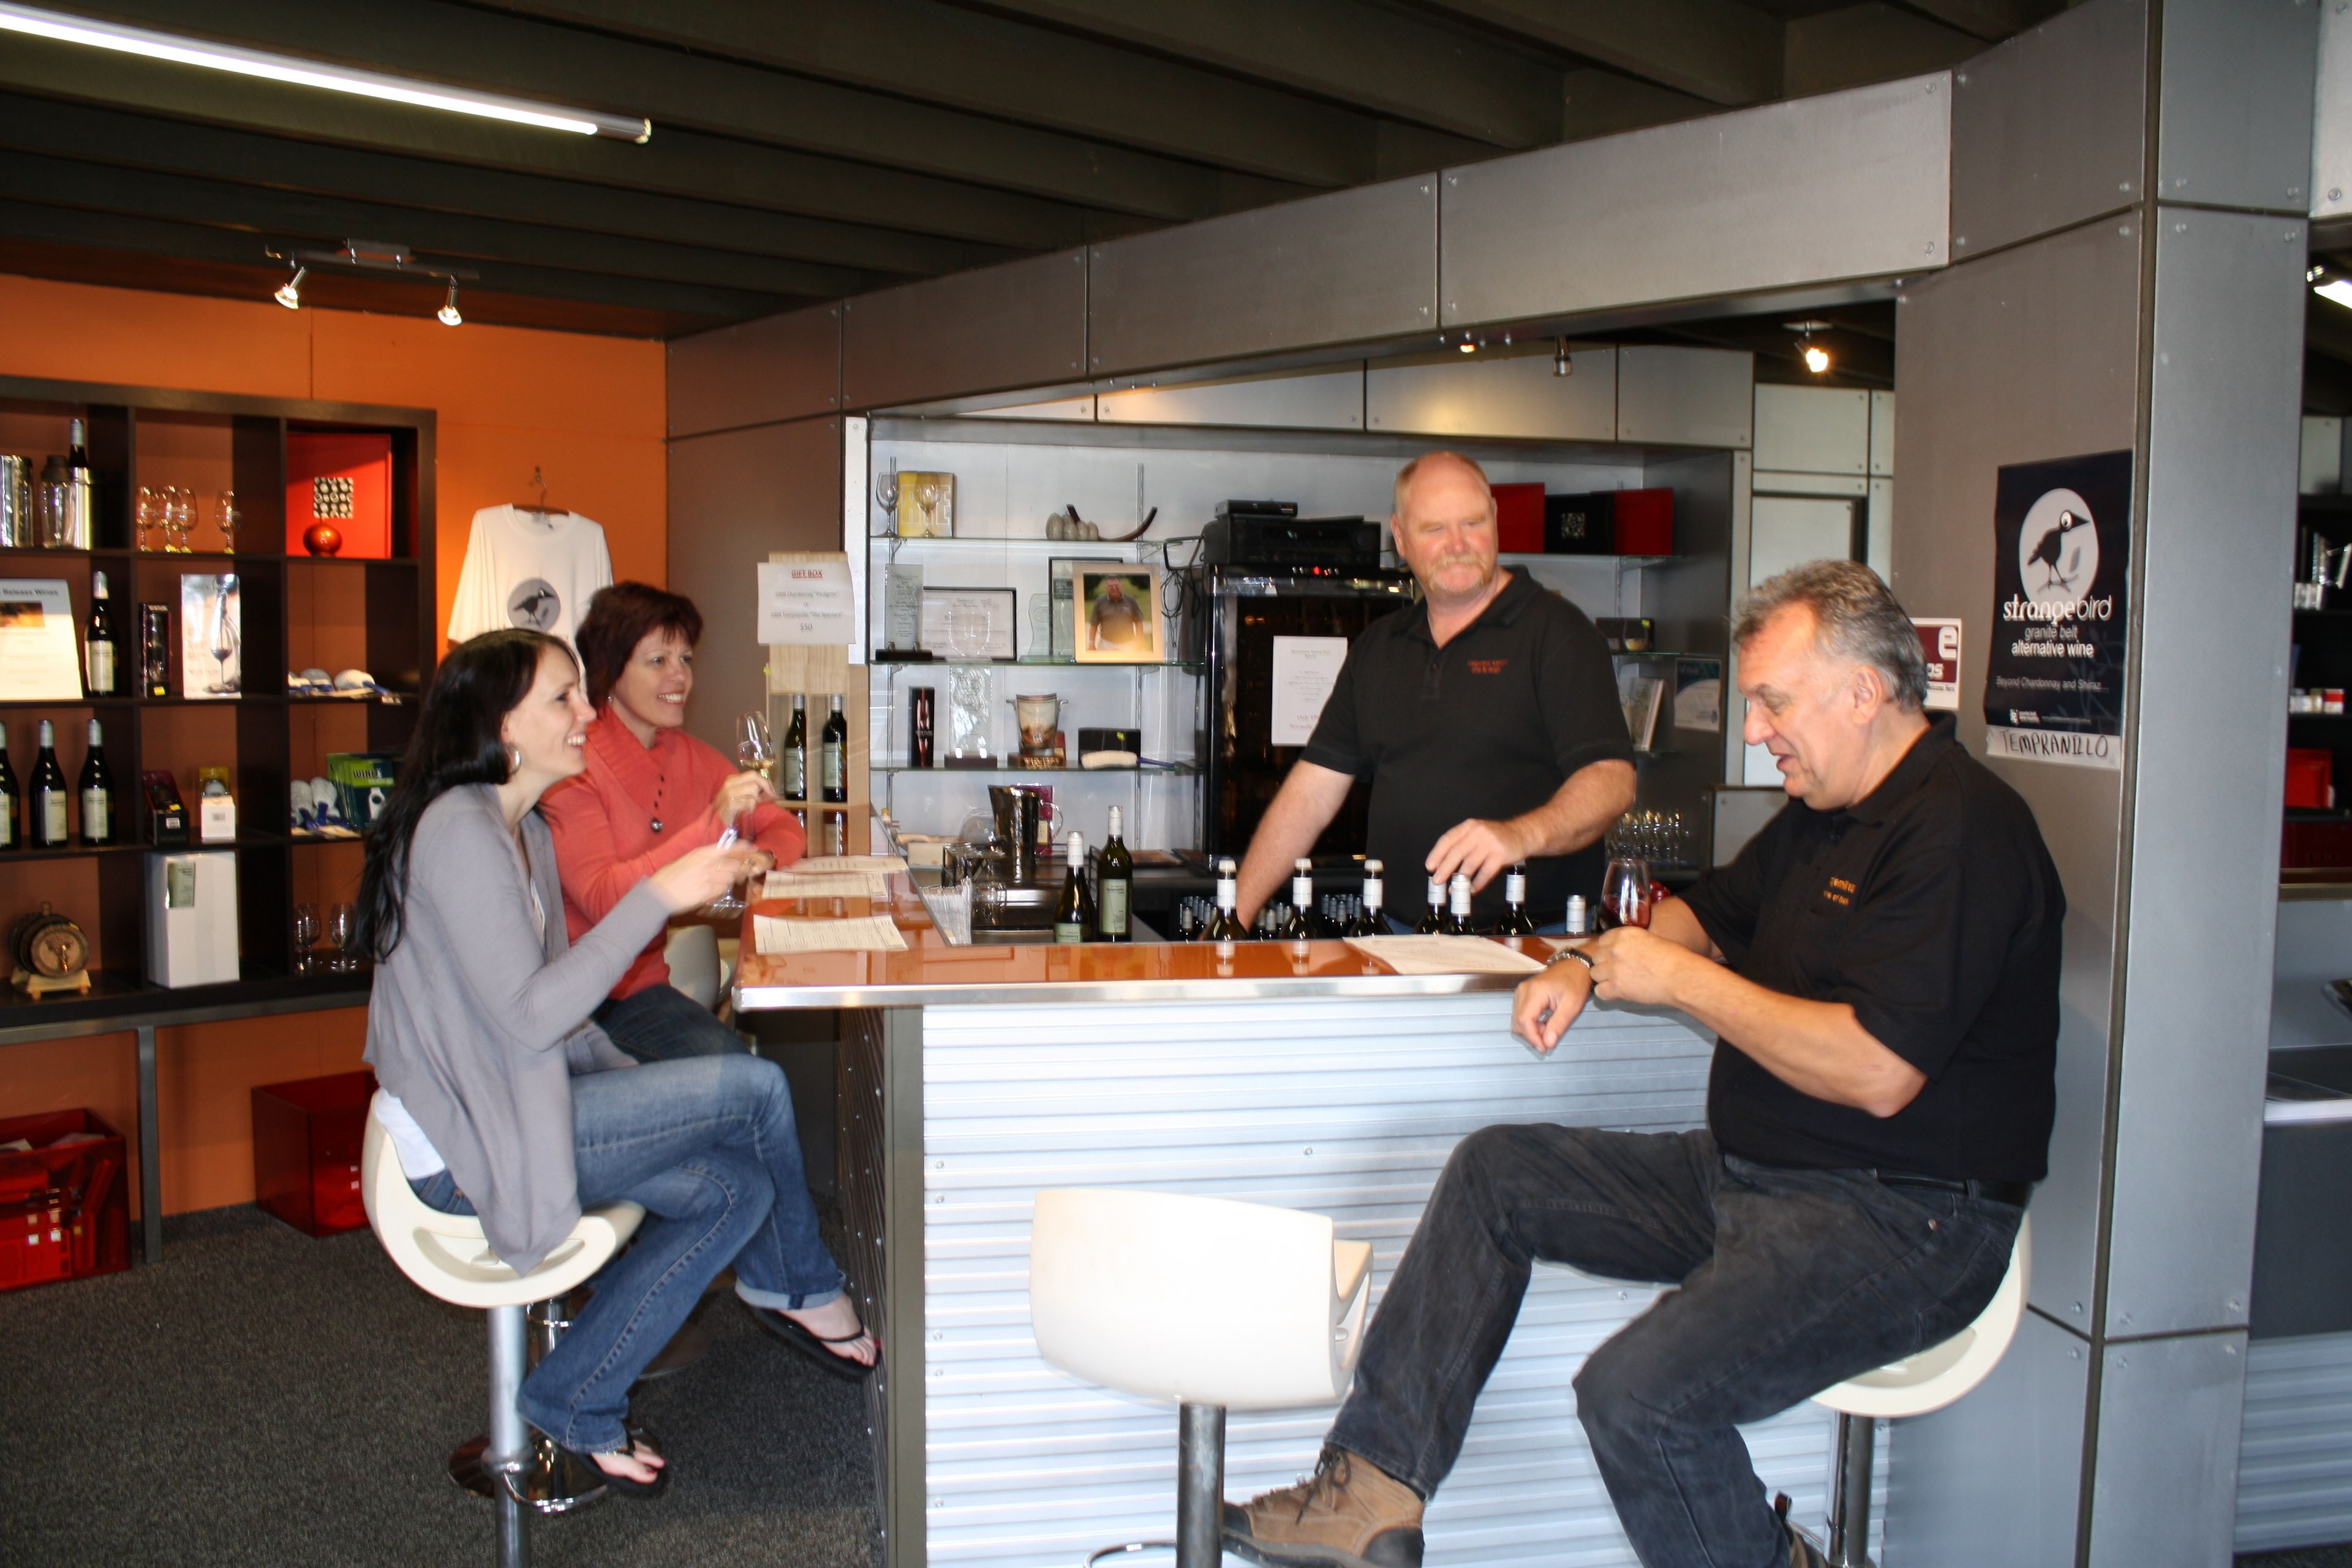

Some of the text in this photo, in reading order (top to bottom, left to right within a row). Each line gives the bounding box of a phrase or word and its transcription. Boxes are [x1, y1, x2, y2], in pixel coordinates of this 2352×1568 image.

[791, 569, 823, 578] GIFT BOX
[2003, 594, 2113, 627] strangebird
[2025, 625, 2078, 641] granite belt
[2011, 640, 2095, 658] alternative wine
[1996, 676, 2021, 688] Beyond
[2021, 677, 2060, 692] Chardonnay
[2062, 679, 2077, 690] and
[1999, 729, 2108, 757] TEMPRANILLO
